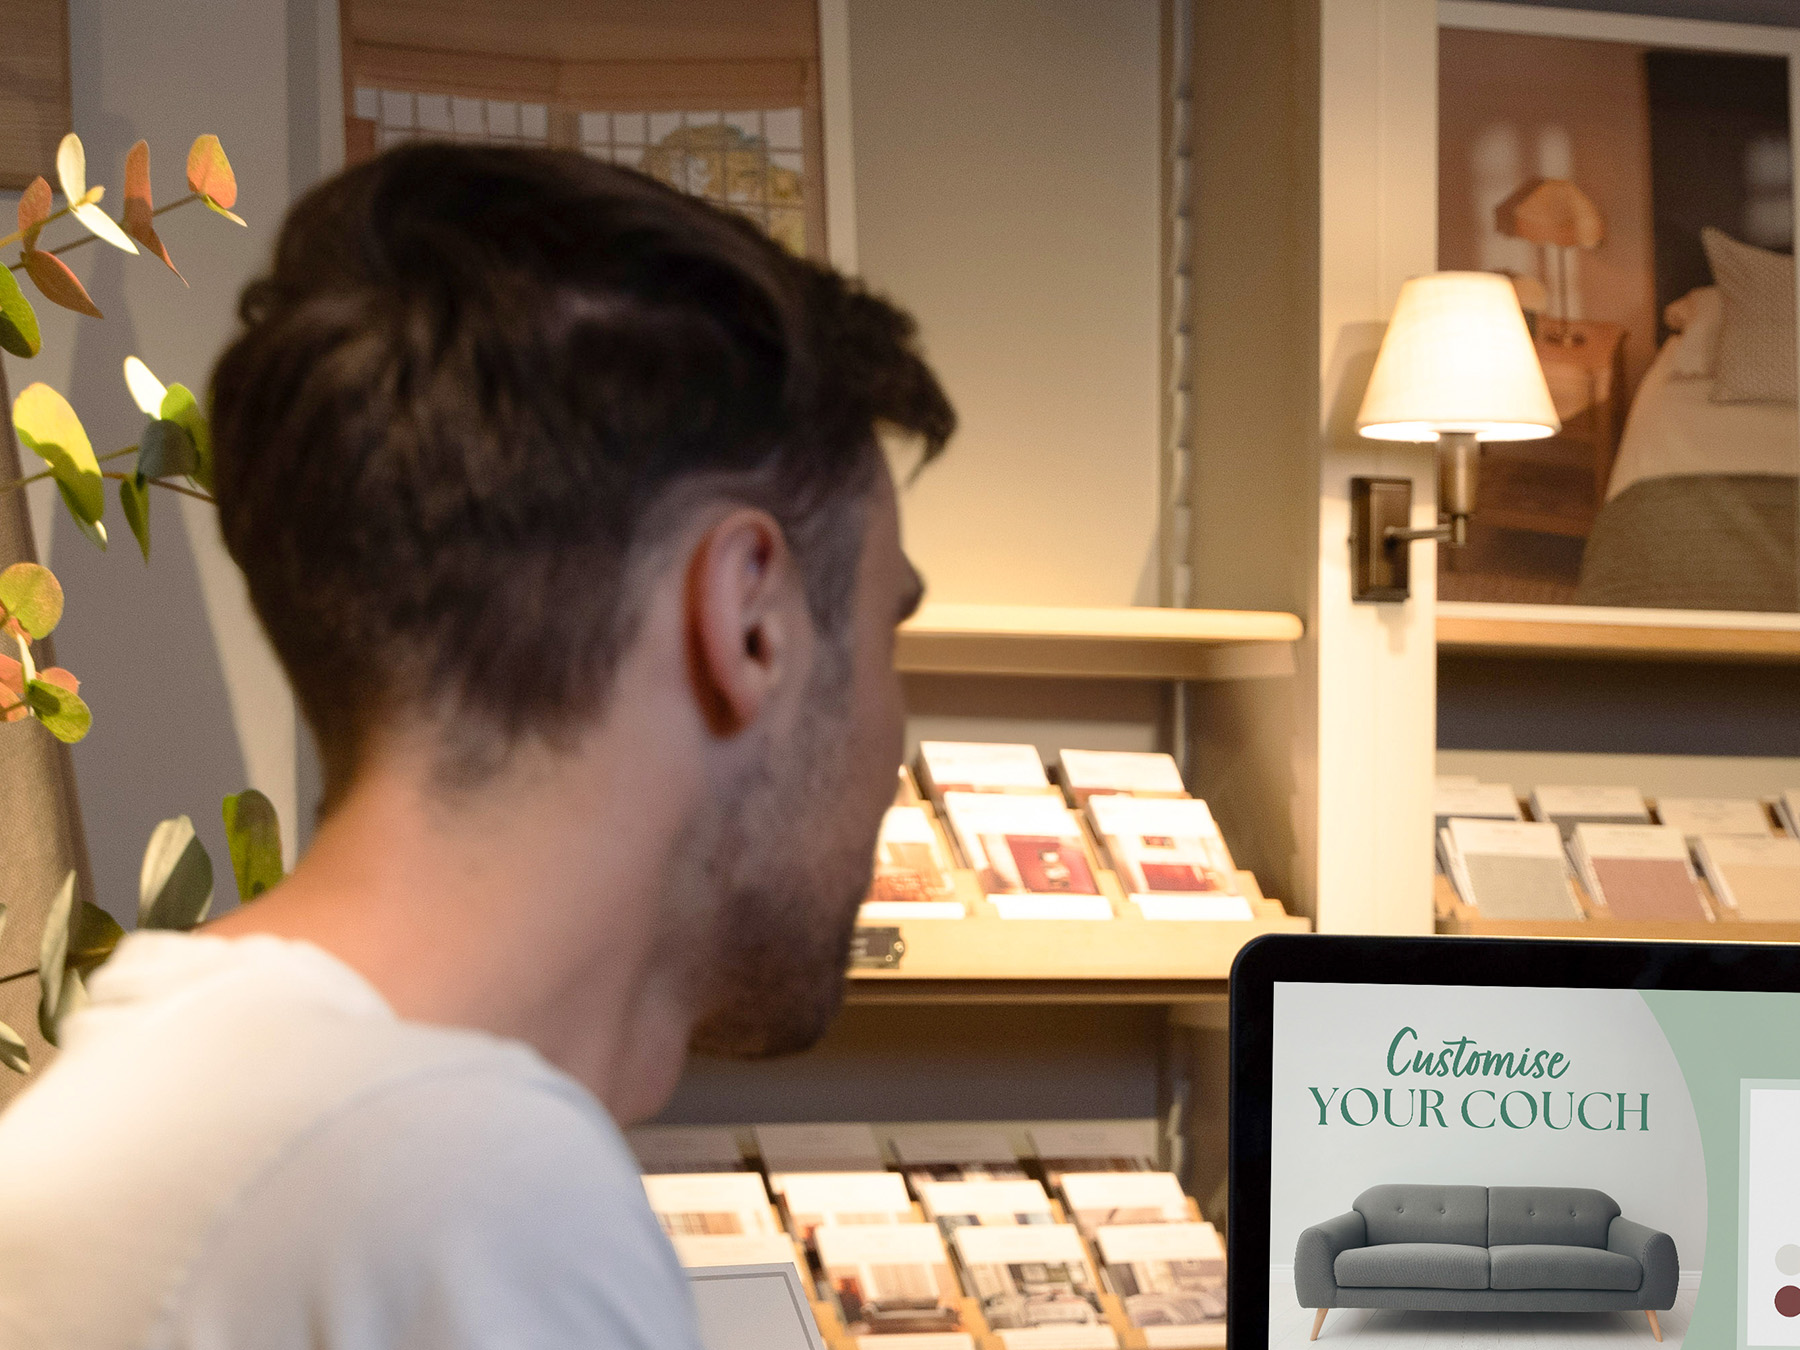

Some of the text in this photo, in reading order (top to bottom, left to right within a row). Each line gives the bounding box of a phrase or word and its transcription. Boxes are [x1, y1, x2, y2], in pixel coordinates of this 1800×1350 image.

[1387, 1026, 1571, 1079] Customise
[1308, 1087, 1650, 1131] YOUR COUCH
